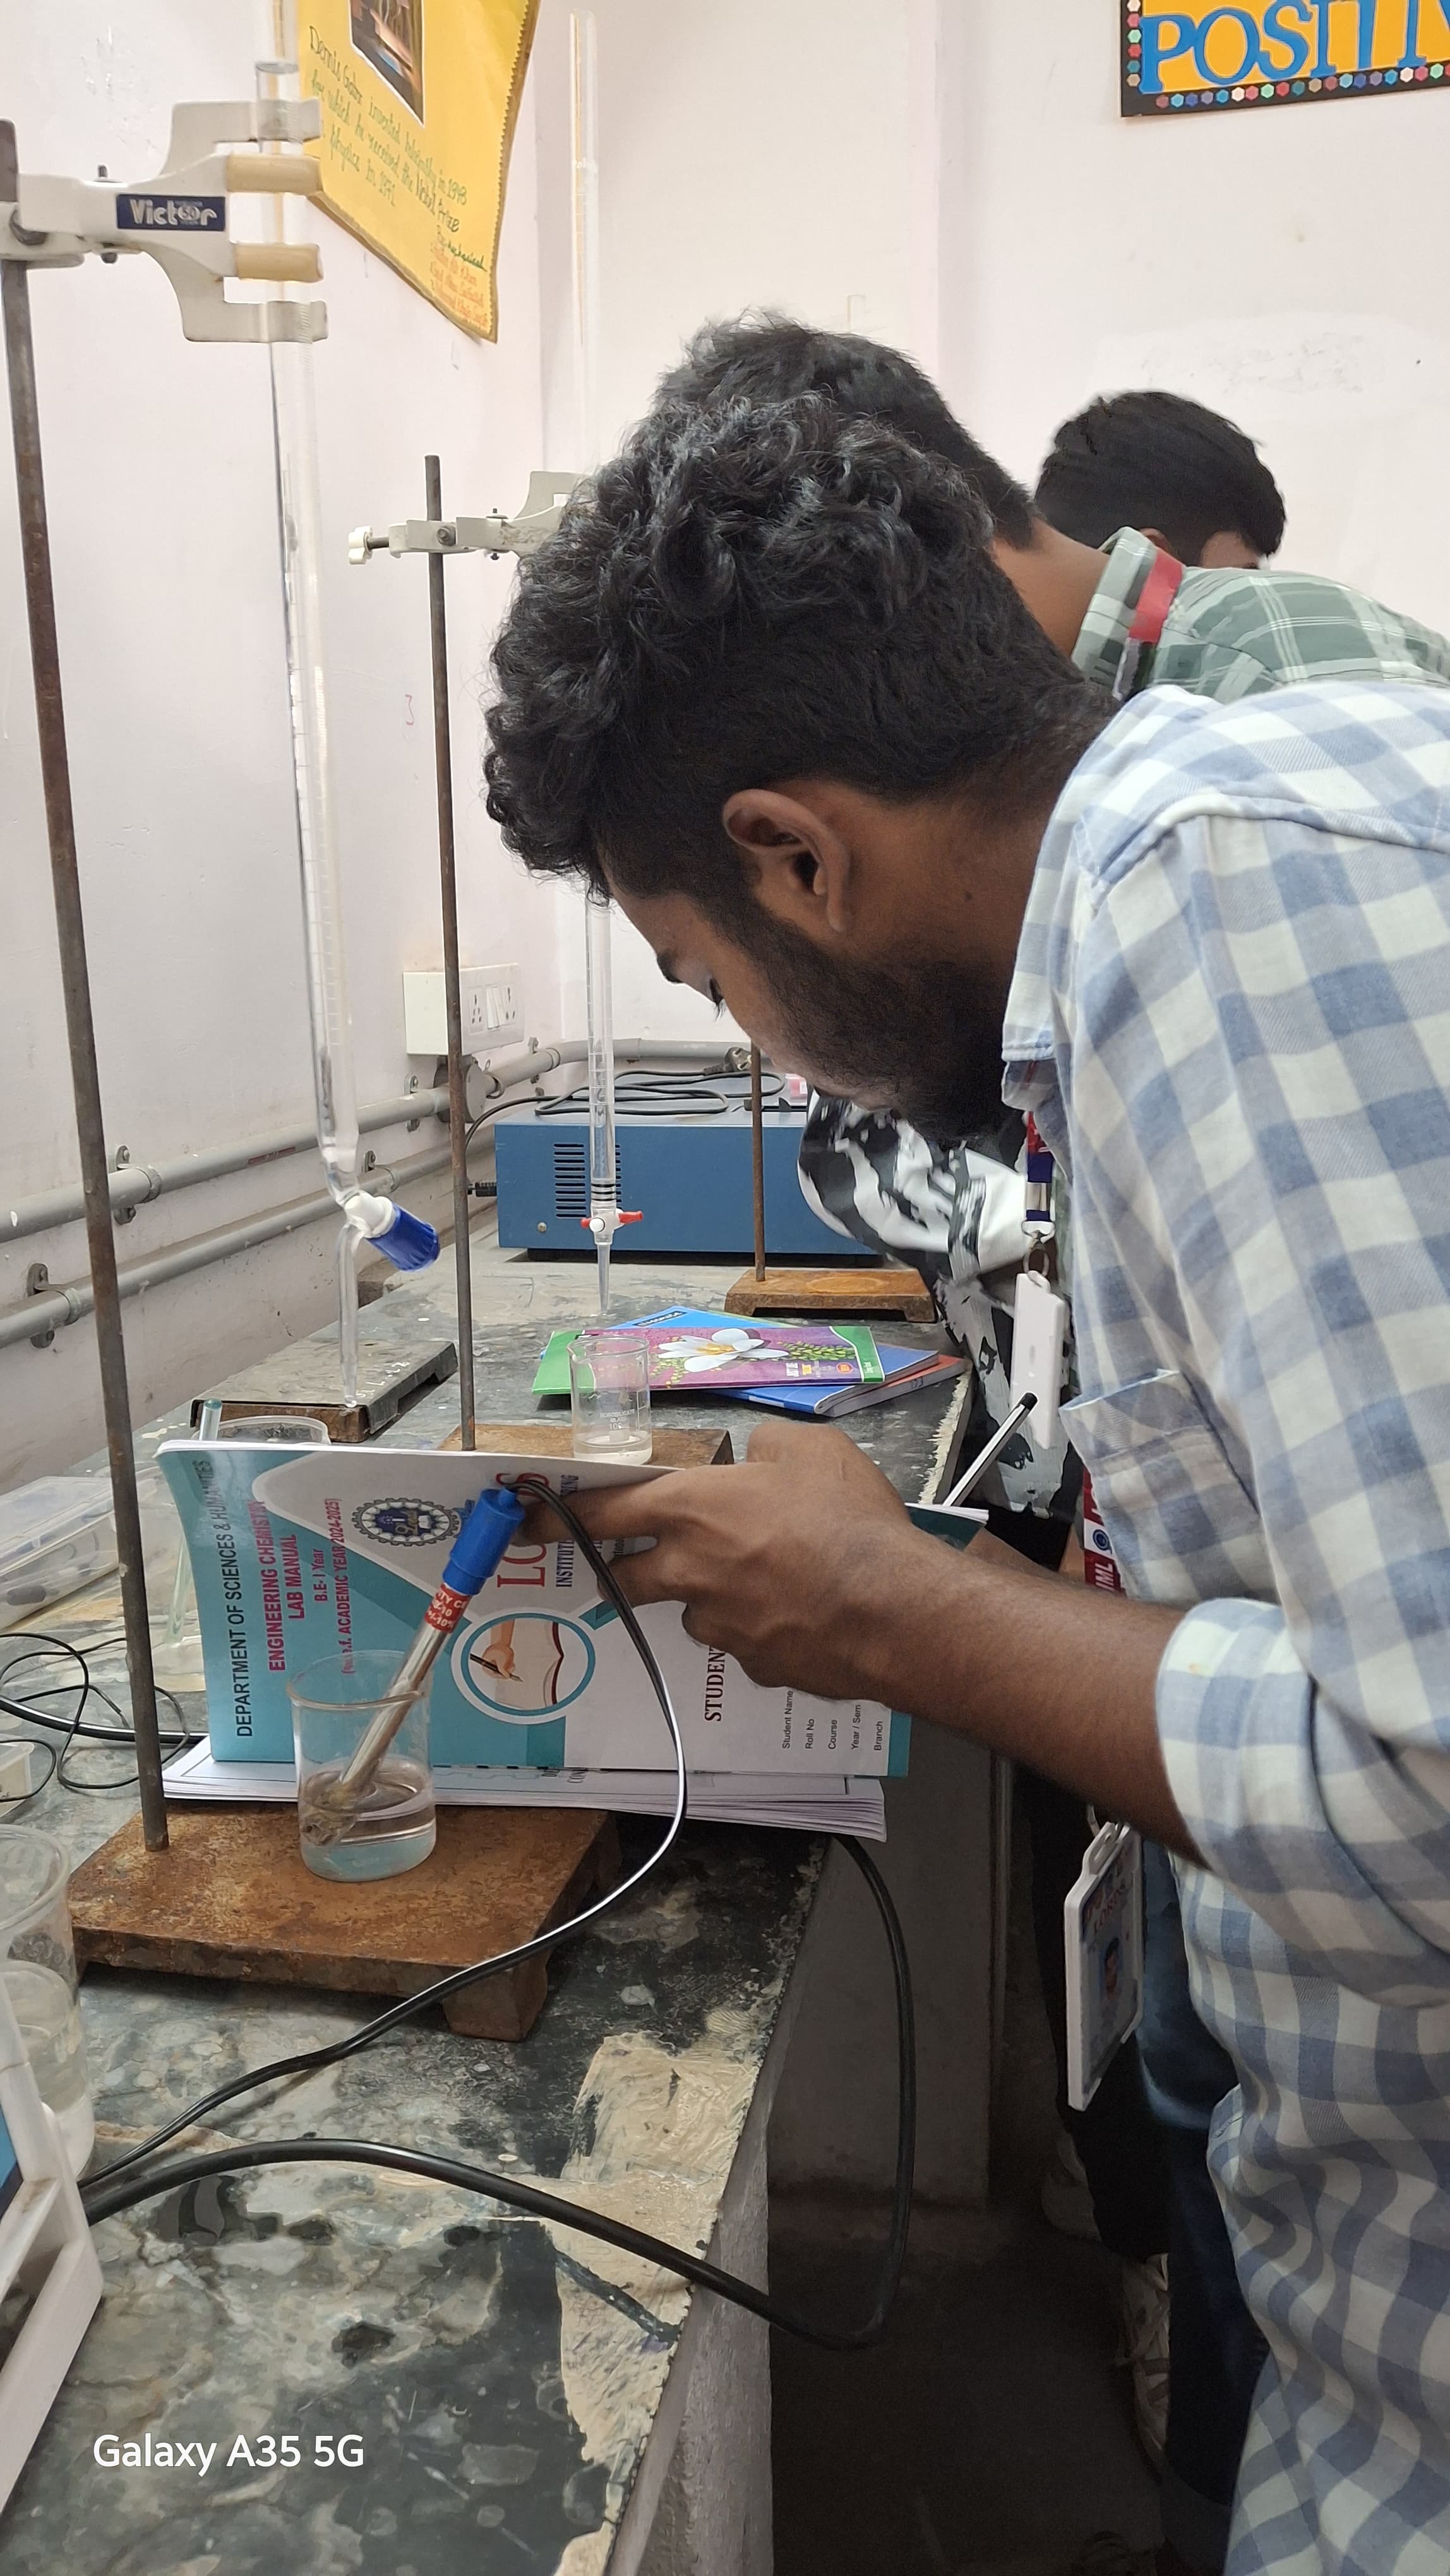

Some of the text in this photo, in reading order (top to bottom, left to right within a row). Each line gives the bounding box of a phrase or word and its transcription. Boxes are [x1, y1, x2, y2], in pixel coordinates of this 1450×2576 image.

[129, 199, 218, 226] Victor
[212, 1522, 231, 1531] &
[324, 1498, 345, 1543] 2024-2025)
[215, 1533, 242, 1601] SCIENCES
[311, 1548, 324, 1571] Year
[331, 1546, 349, 1572] YEAR
[279, 1534, 305, 1619] LAB MANUAL
[225, 1604, 245, 1625] OF
[260, 1568, 286, 1672] ENGINEERING
[334, 1575, 352, 1635] ACADEMIC
[229, 1629, 253, 1737] DEPARTMENT
[782, 1690, 794, 1749] Student Name
[853, 1704, 861, 1724] Sem
[805, 1718, 815, 1750] Roll No
[828, 1719, 838, 1750] Course
[851, 1729, 860, 1750] Year
[873, 1720, 884, 1751] Branch
